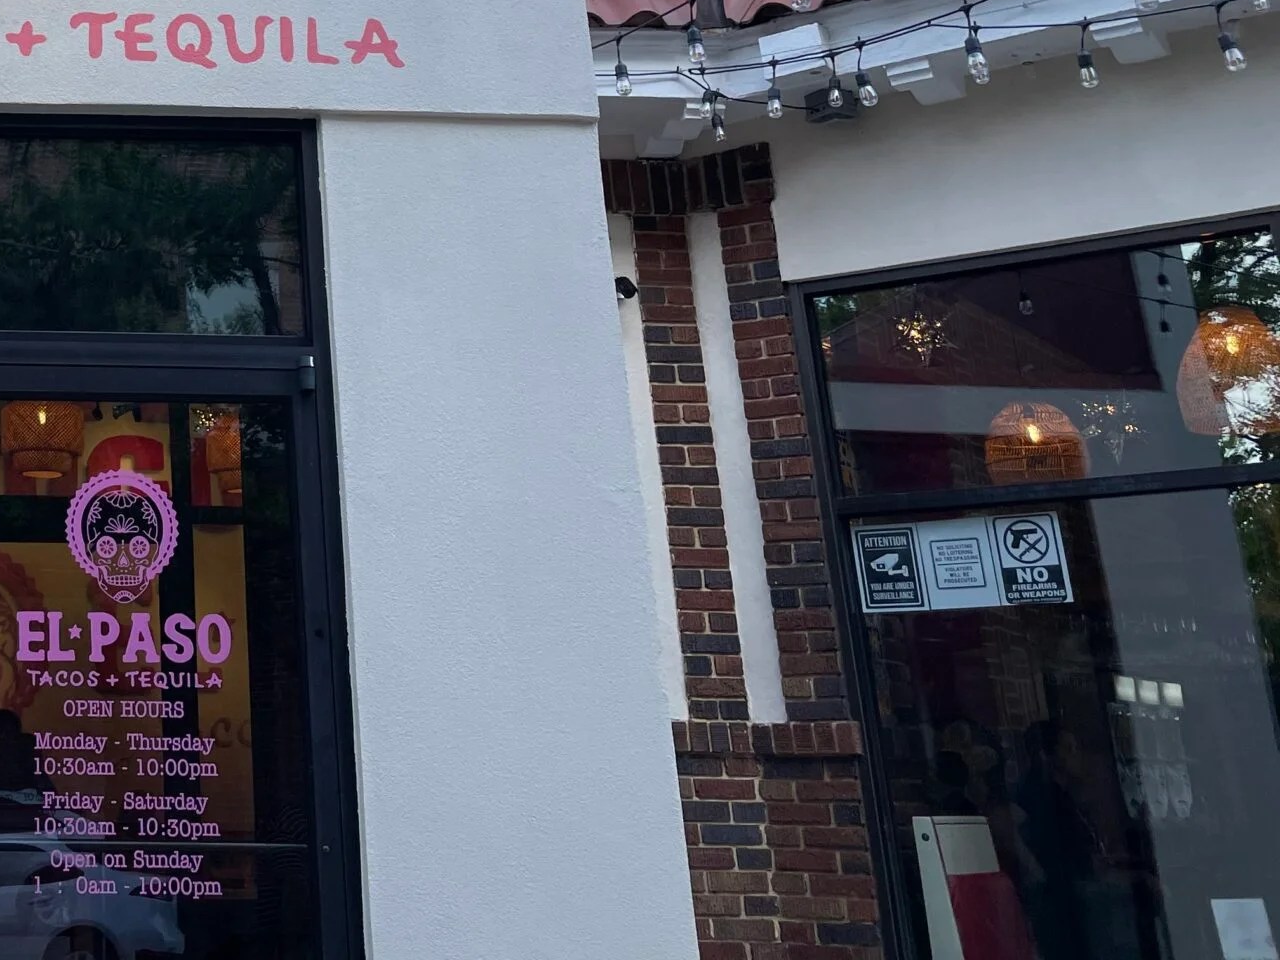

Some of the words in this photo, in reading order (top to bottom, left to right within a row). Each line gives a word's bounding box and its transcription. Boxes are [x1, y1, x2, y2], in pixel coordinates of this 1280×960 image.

[6, 21, 46, 56] +
[70, 12, 404, 69] TEQUILA
[864, 535, 907, 548] ATTENTION
[1015, 566, 1049, 583] NO
[870, 583, 882, 591] YOU
[883, 582, 894, 590] ARE
[895, 581, 915, 590] UNDER
[872, 590, 915, 600] SURVEILLANCE
[1012, 582, 1058, 592] FIREARMS
[1021, 589, 1066, 599] WEAPONS
[16, 610, 76, 662] EL
[87, 611, 232, 664] PASO
[26, 669, 101, 687] TACOS
[106, 674, 120, 687] +
[125, 670, 223, 690] TEQUILA
[63, 699, 114, 718] OPEN
[119, 700, 185, 719] HOURS
[34, 732, 108, 755] Monday
[126, 733, 216, 756] Thursday
[34, 757, 116, 776] 10:30am
[136, 758, 219, 780] 10:00pm
[42, 791, 105, 814] Friday
[123, 792, 209, 814] Saturday
[34, 817, 117, 836] 10:30am
[137, 818, 221, 839] 10:30pm
[50, 849, 98, 872] Open
[103, 853, 128, 868] on
[133, 849, 205, 873] Sunday
[138, 877, 223, 899] 10:00pm
